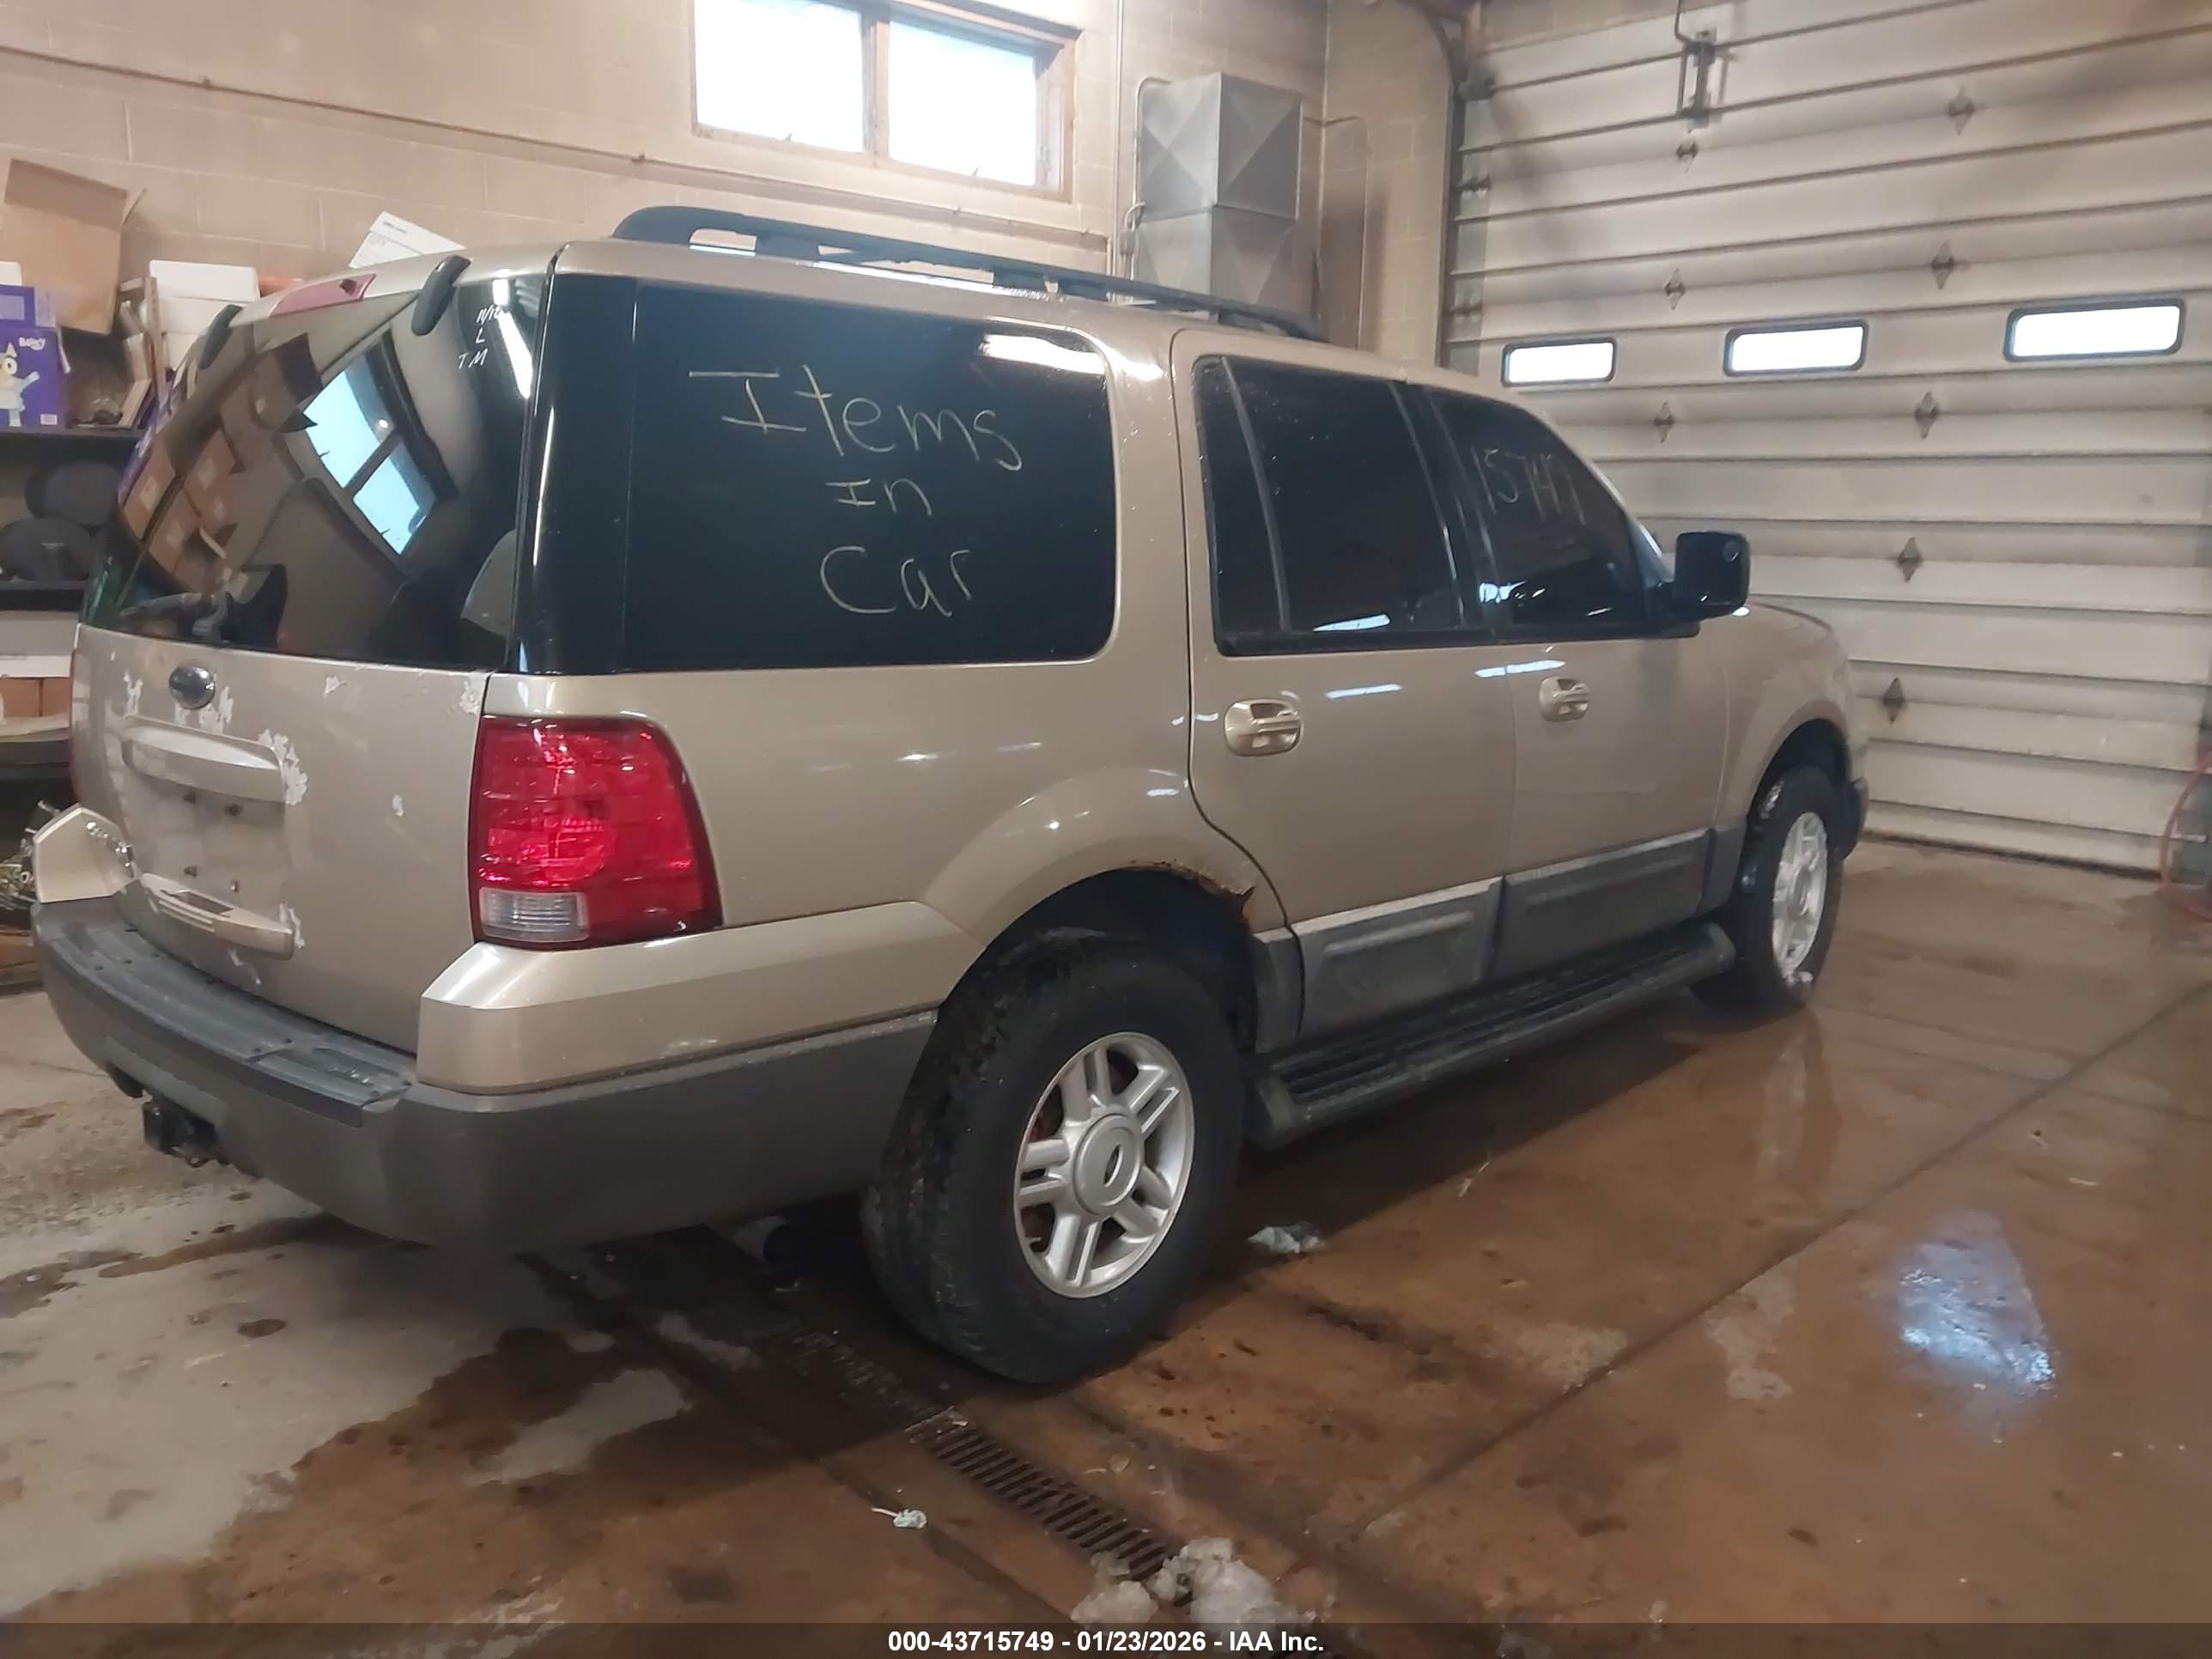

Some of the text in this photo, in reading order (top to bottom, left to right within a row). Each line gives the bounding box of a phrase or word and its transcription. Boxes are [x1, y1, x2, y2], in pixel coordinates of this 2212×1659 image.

[475, 327, 486, 344] L
[689, 363, 1022, 471] Items
[820, 545, 972, 617] Car
